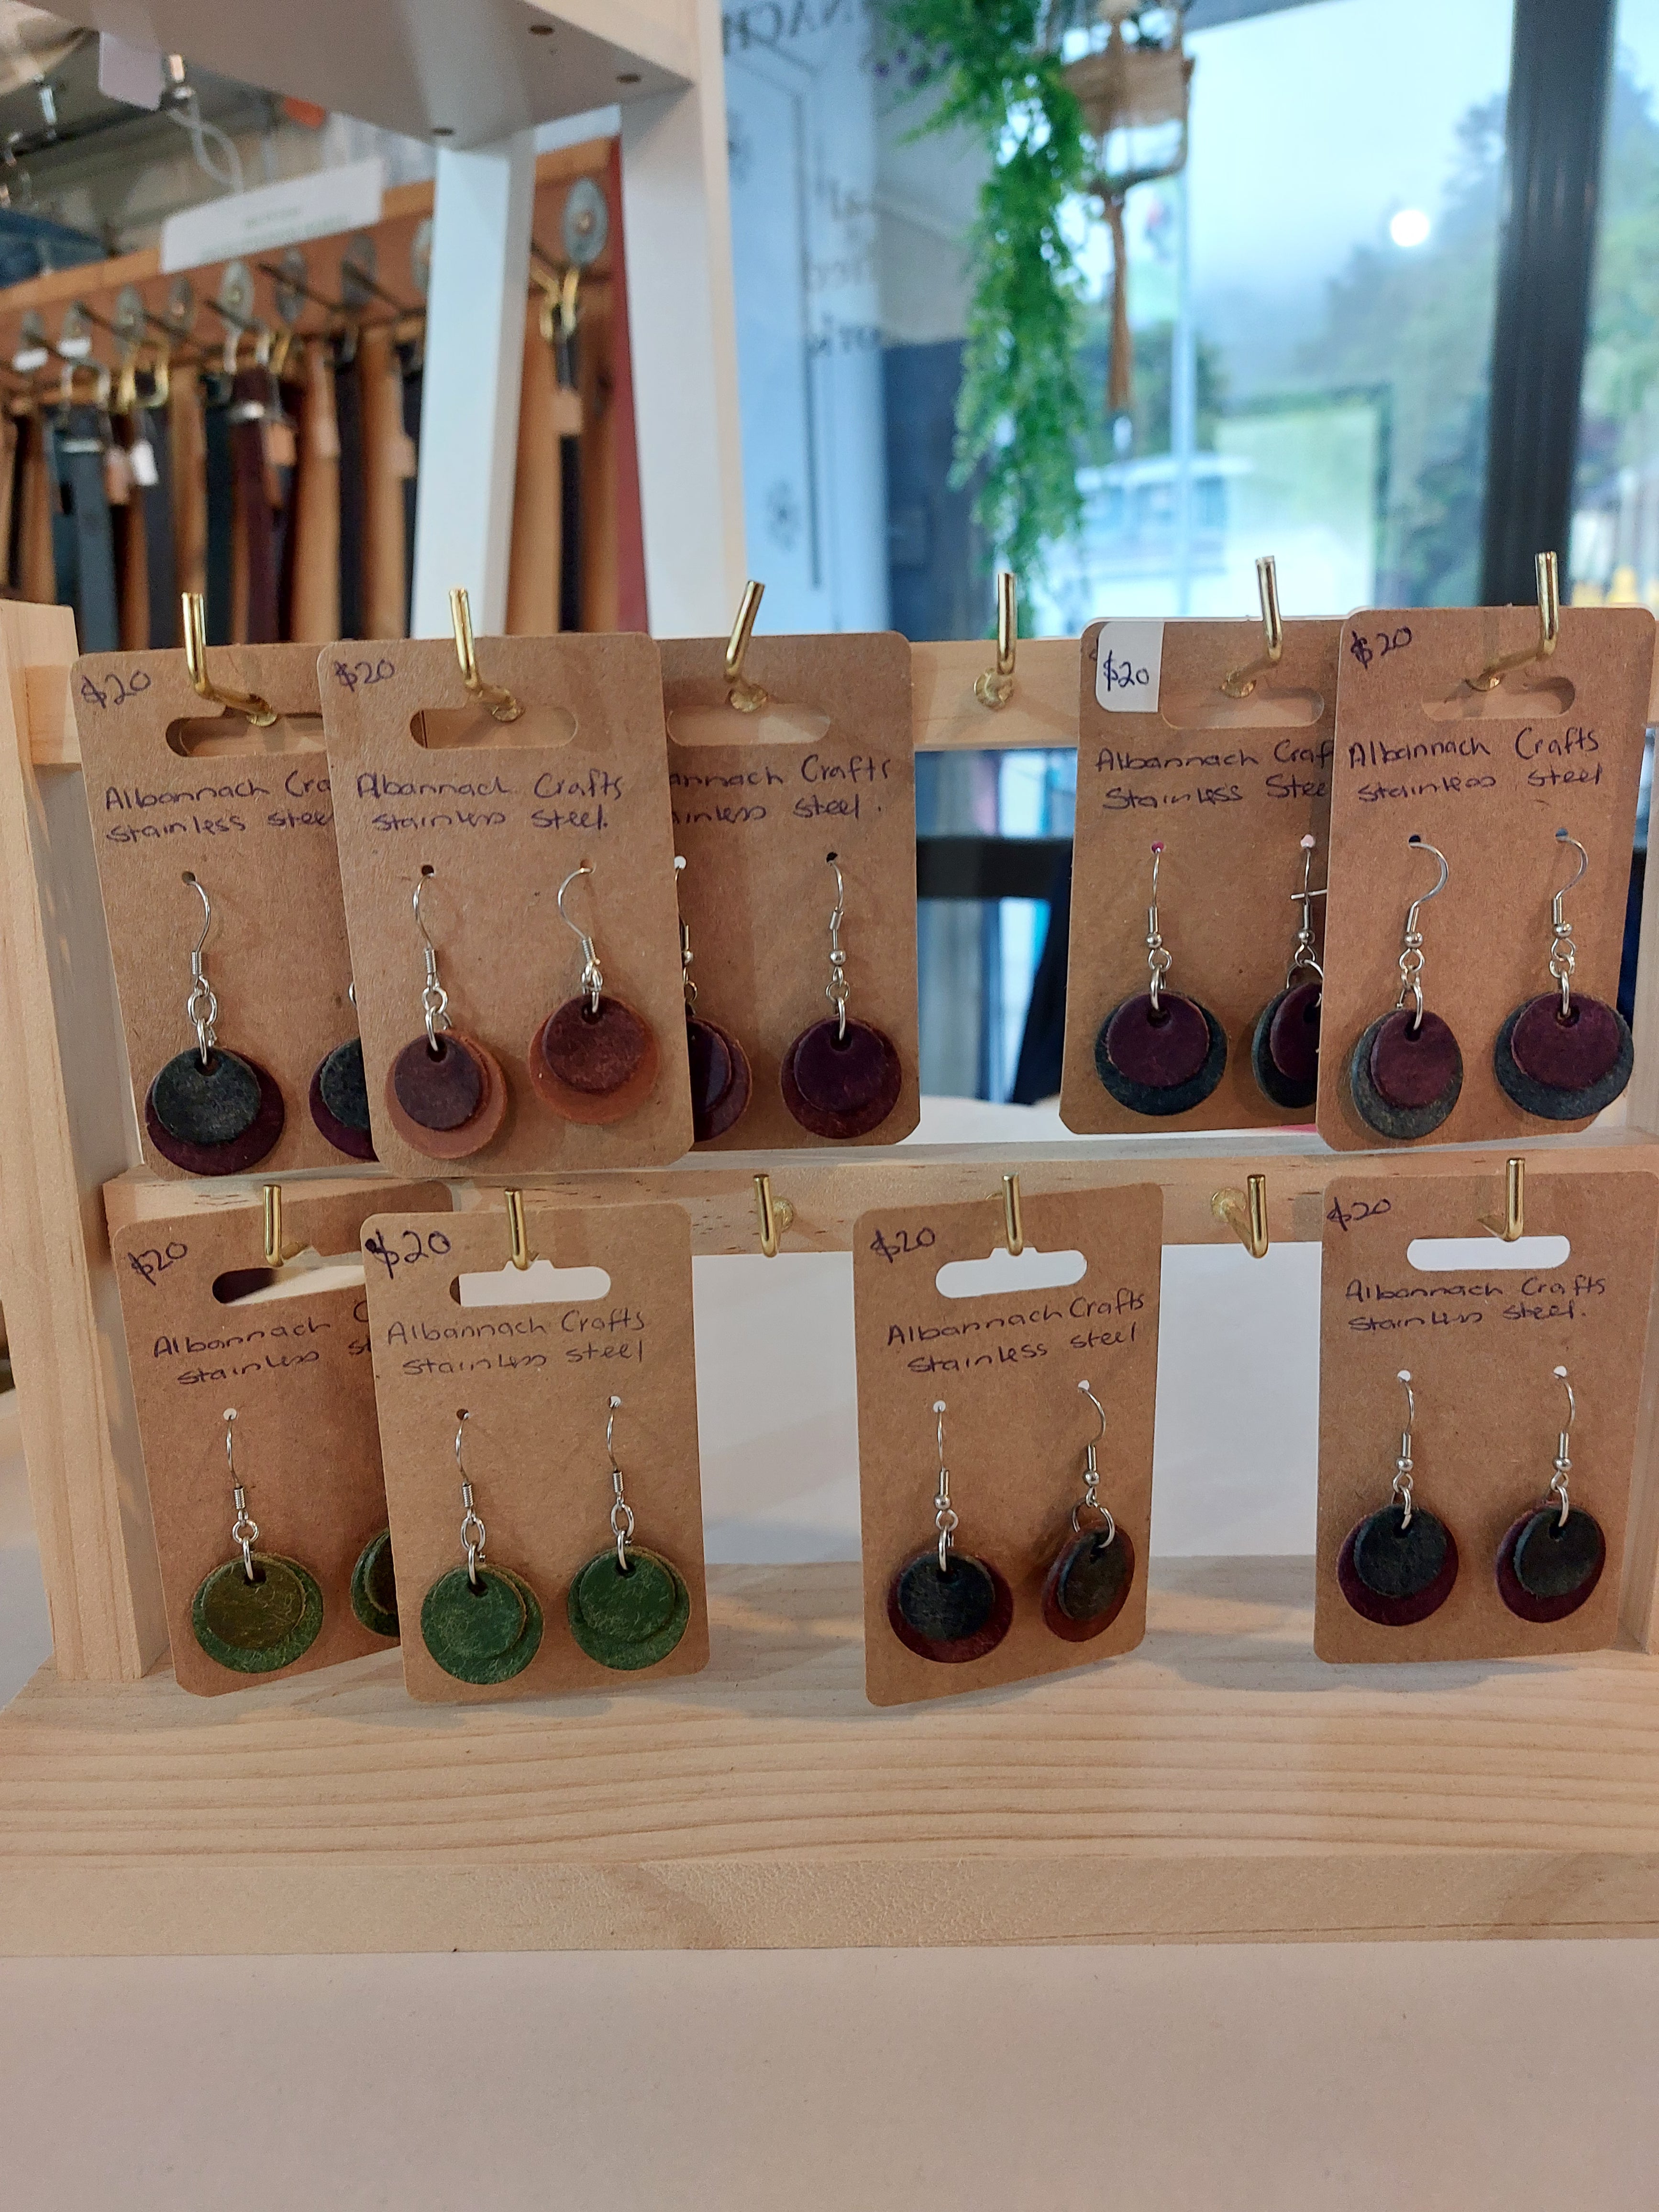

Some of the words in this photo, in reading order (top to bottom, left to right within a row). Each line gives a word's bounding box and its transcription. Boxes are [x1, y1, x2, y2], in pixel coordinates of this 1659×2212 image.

[1350, 624, 1413, 670] $20
[334, 660, 395, 692] $20
[1102, 649, 1150, 692] $20
[81, 671, 152, 708] $20
[1095, 748, 1259, 773] Albannach
[1273, 739, 1334, 770] Craf
[1349, 737, 1491, 769] Albannach
[1515, 726, 1599, 761] Crafts
[533, 767, 623, 801] Crafts
[801, 754, 891, 784] Crafts
[1265, 773, 1329, 799] Stee
[106, 779, 270, 810] Albannach
[285, 770, 331, 797] Cra
[1326, 1196, 1392, 1232] $20
[128, 1241, 188, 1286] $20
[365, 1228, 452, 1280] $20
[870, 1227, 936, 1264] $20
[1345, 1278, 1503, 1303] Albannach
[1521, 1273, 1606, 1297] Crafts
[387, 1317, 548, 1345] Albannach
[560, 1308, 646, 1334] Crafts
[887, 1304, 1062, 1347] Albannach
[1069, 1287, 1145, 1319] Crafts
[153, 1316, 332, 1359] Albannach
